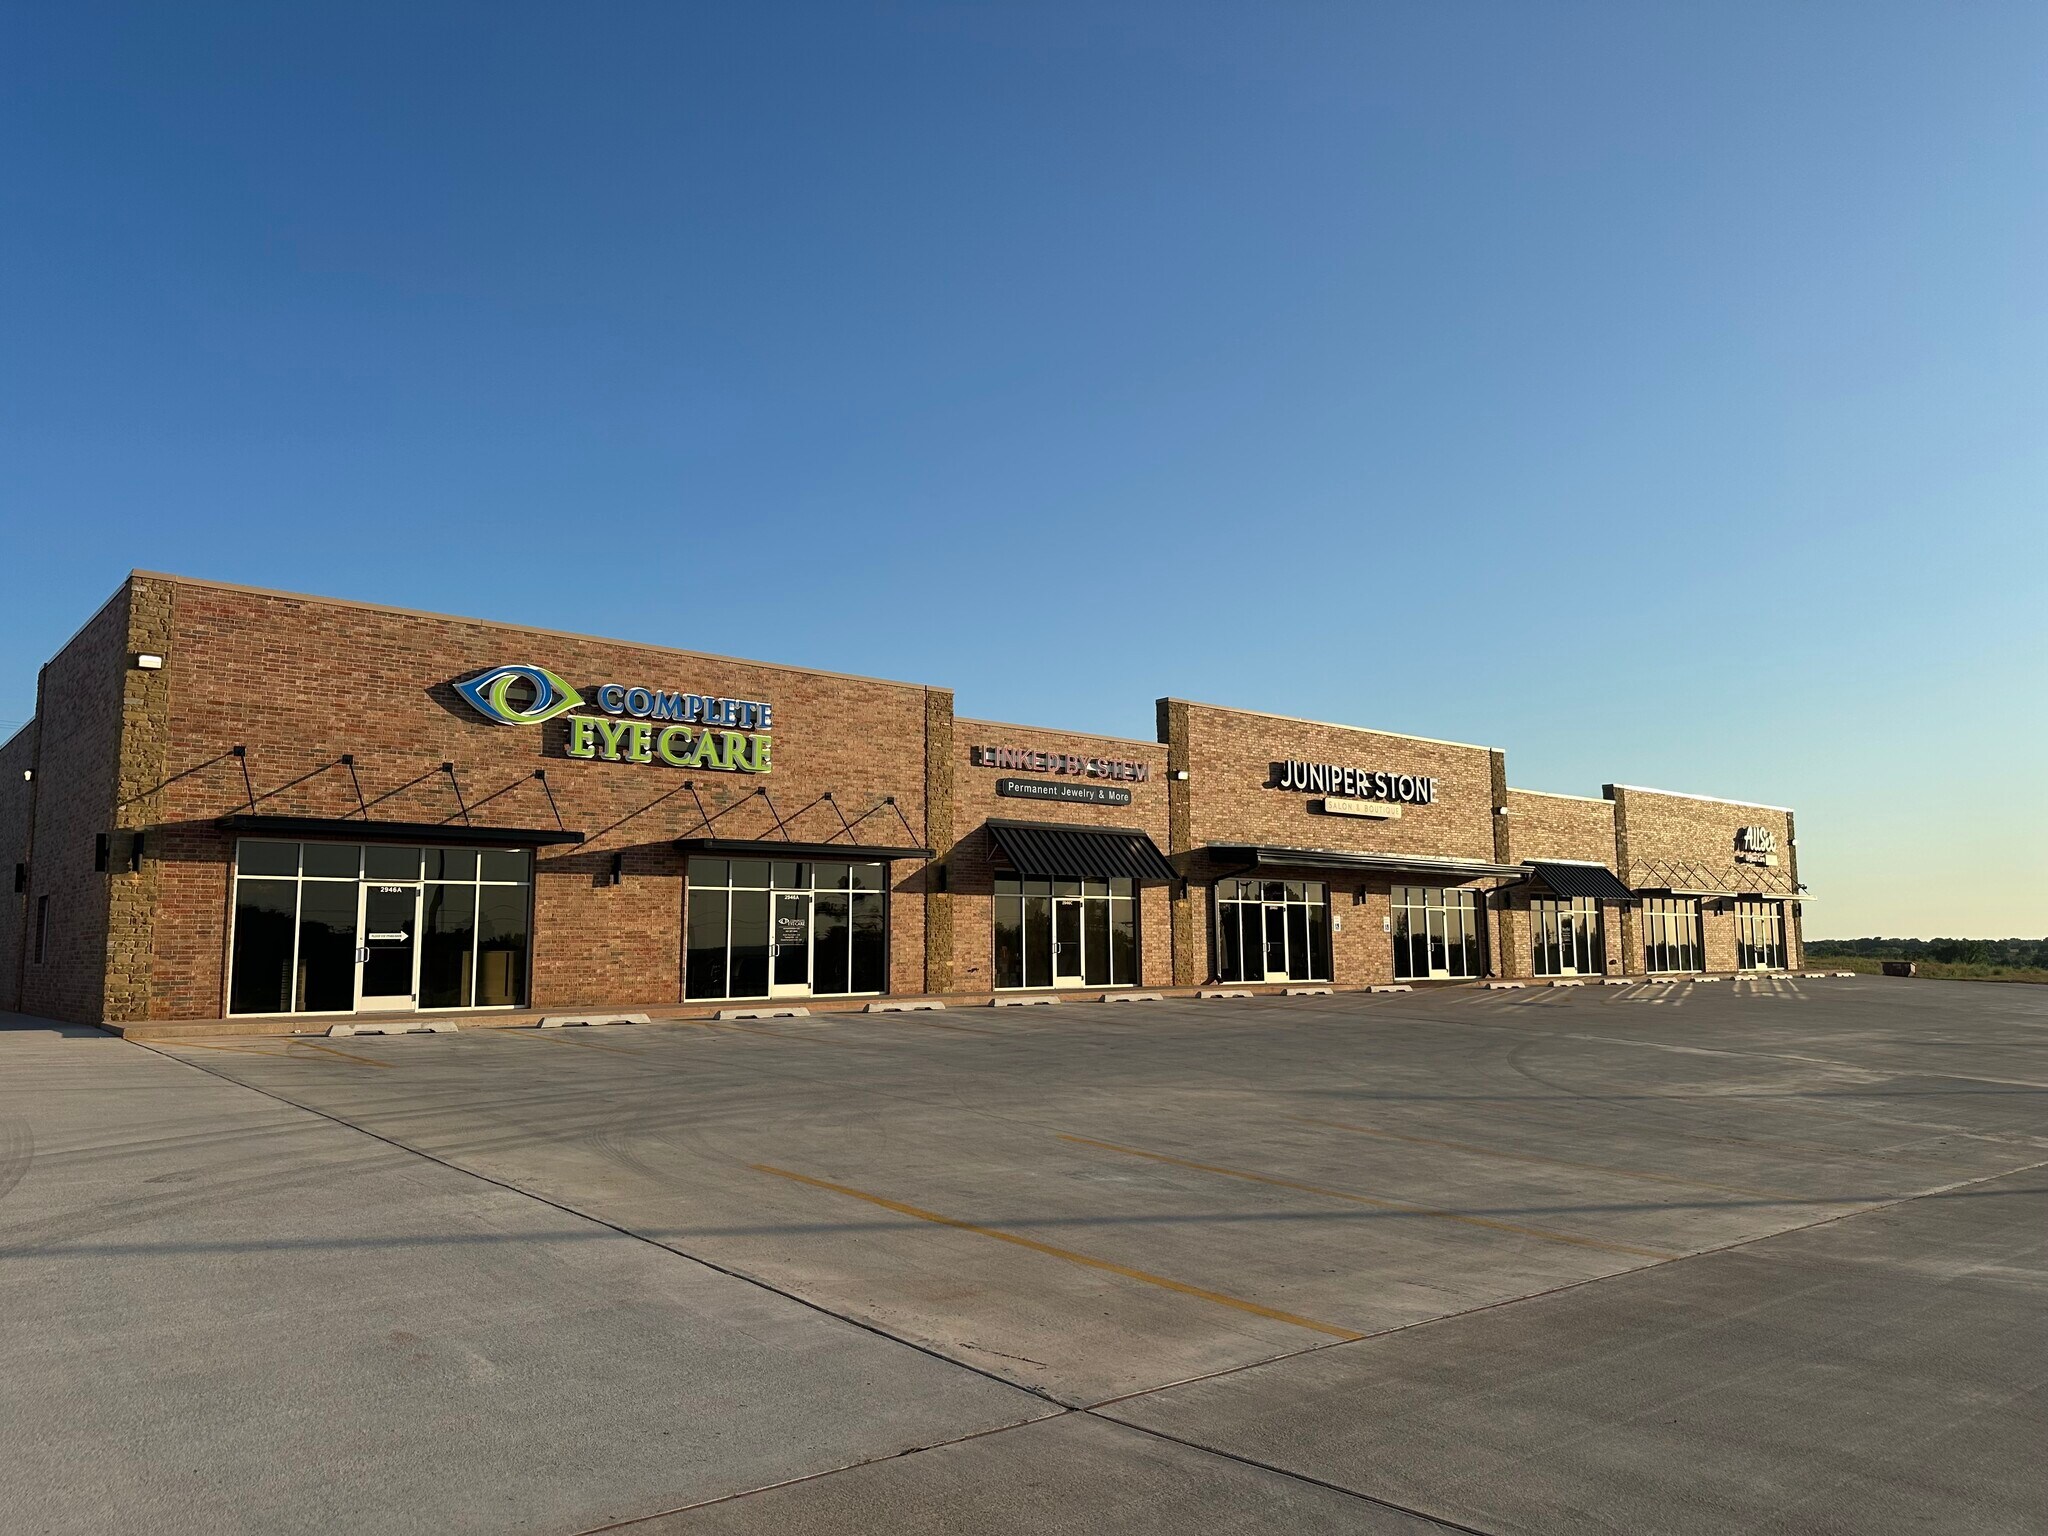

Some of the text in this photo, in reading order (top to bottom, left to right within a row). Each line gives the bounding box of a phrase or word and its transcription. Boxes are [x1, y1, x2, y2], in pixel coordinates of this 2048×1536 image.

[597, 683, 773, 730] COMPLETE
[567, 715, 773, 773] EYE CARE
[982, 744, 1060, 773] LINKED
[1064, 753, 1091, 775] BY
[1008, 781, 1129, 801] Permanent Jewelry & More
[1281, 760, 1439, 803] JUNIPER STONE
[1328, 801, 1353, 811] SALON
[1364, 804, 1399, 815] BOUTIQUE
